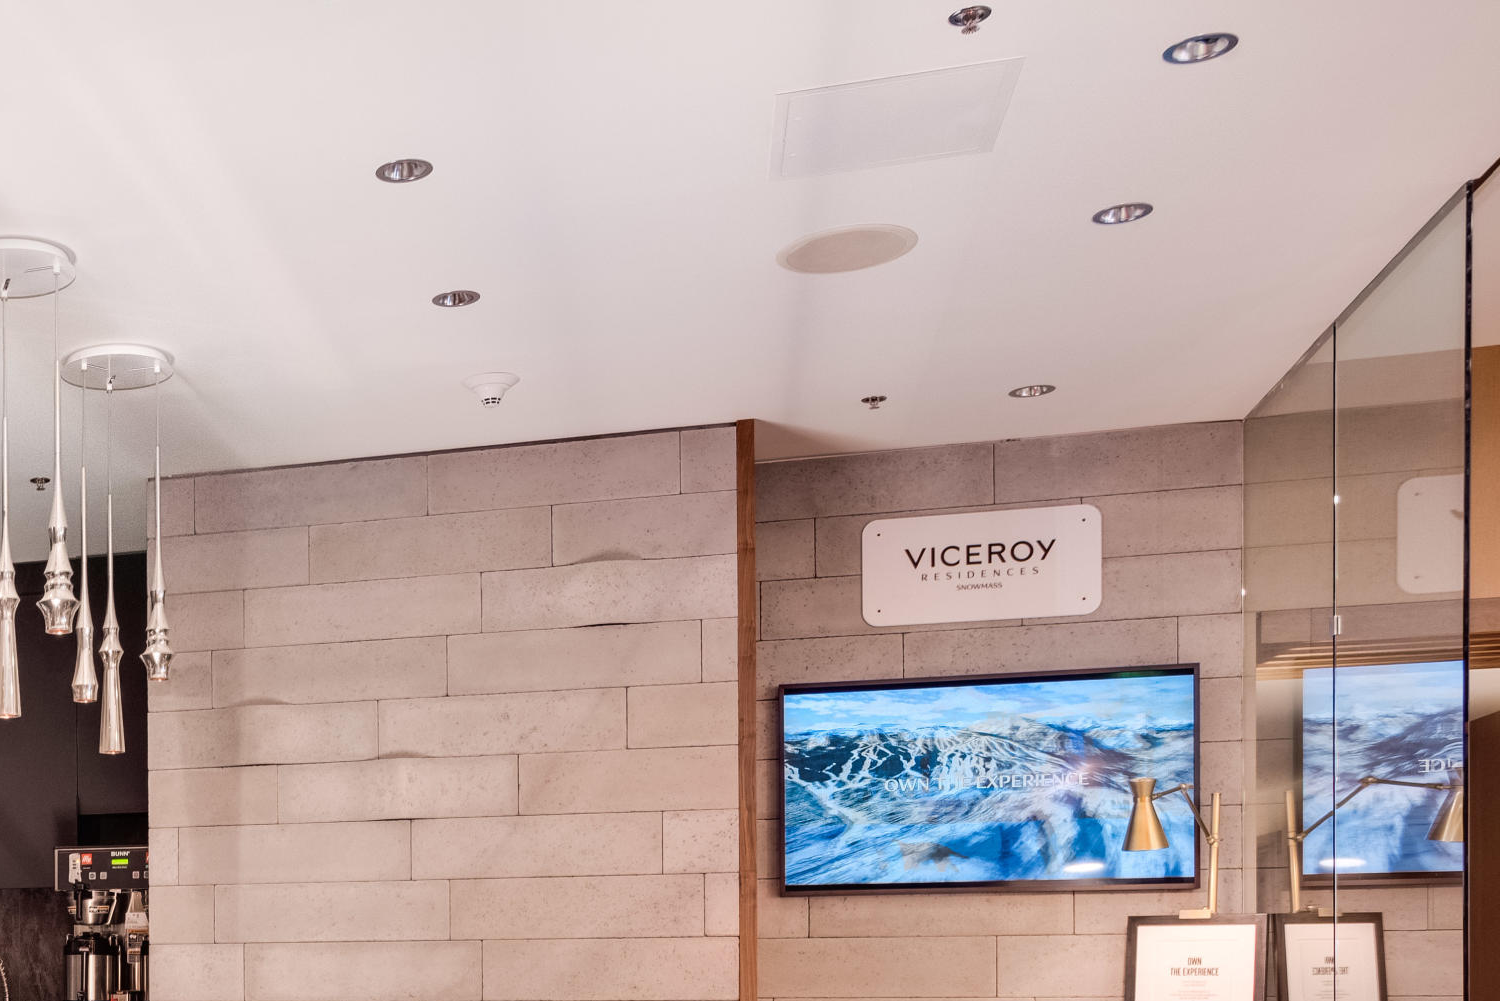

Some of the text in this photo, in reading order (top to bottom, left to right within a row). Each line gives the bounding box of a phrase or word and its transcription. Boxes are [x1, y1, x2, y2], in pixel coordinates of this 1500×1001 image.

[904, 538, 1057, 570] VICEROY
[920, 566, 1040, 582] RESIDENCES
[956, 582, 1003, 591] SNOWMASS
[884, 777, 929, 792] OWN
[976, 772, 1090, 789] EXPERIENCE
[1187, 957, 1202, 966] OWN
[1170, 967, 1219, 976] THE EXPERIENCE
